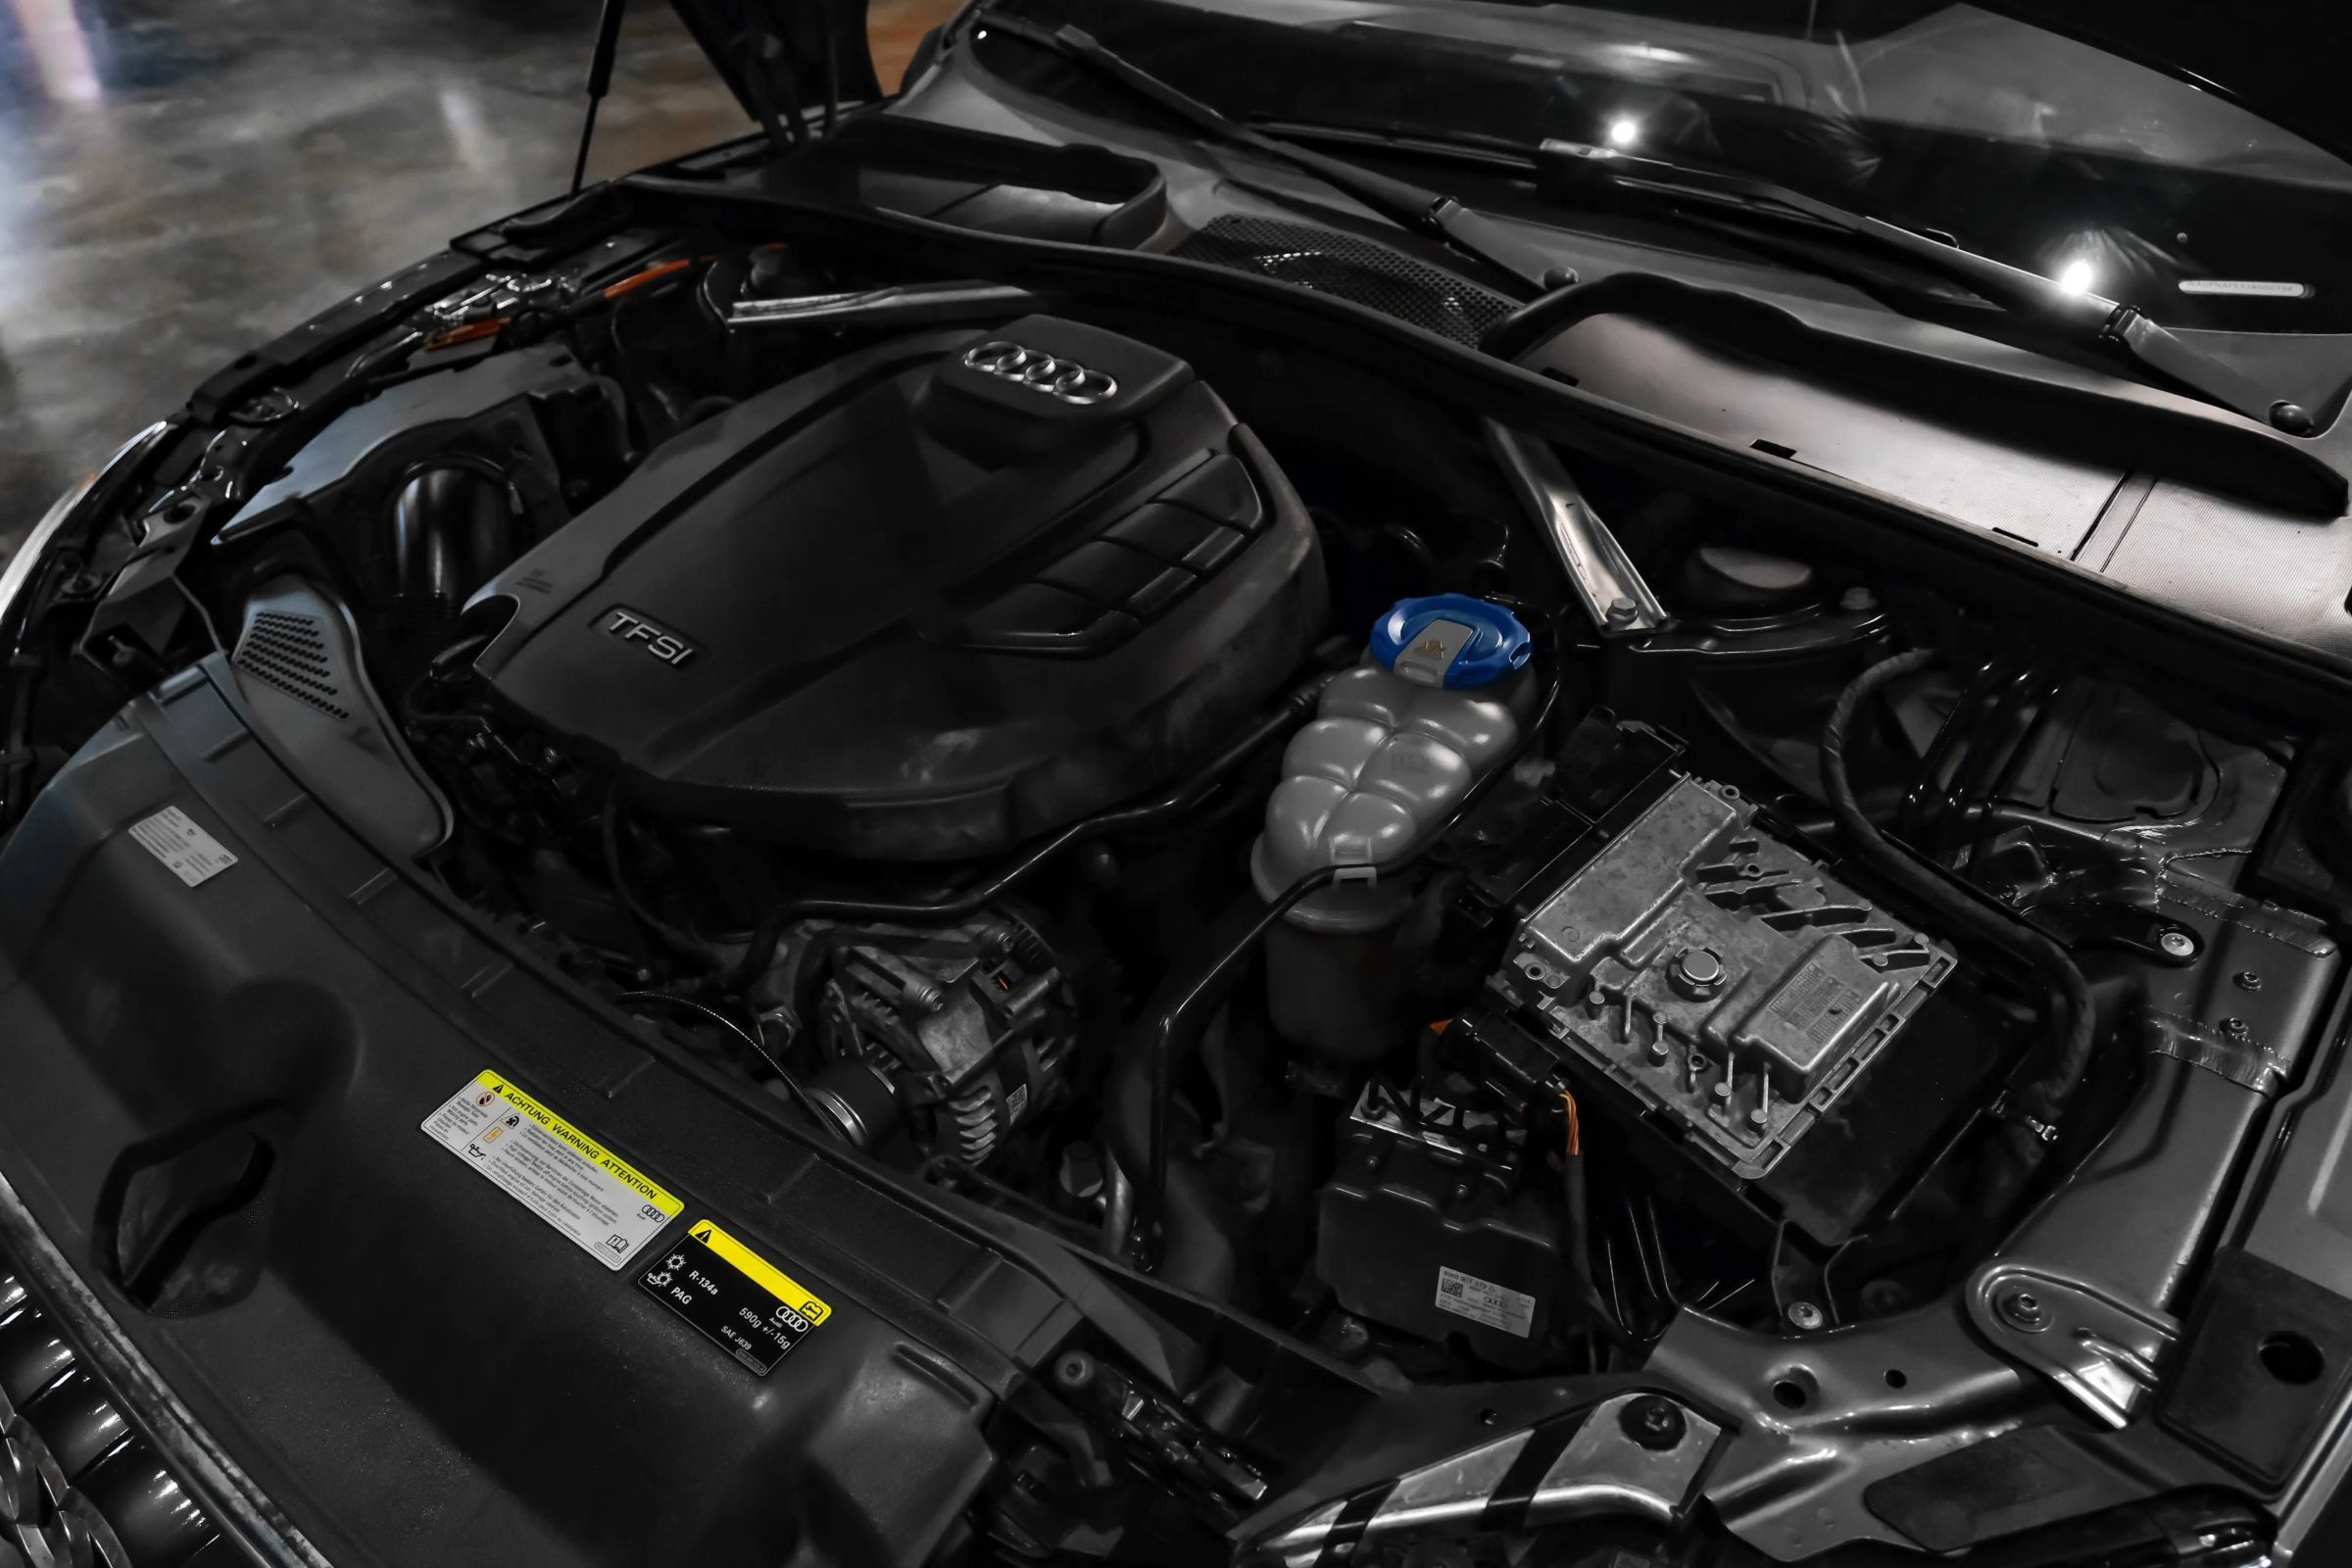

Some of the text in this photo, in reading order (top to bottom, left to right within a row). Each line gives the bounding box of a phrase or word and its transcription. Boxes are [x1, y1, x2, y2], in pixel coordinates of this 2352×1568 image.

[609, 612, 694, 664] TFSI
[504, 1091, 551, 1126] ACHTUNG
[551, 1123, 600, 1159] WARNING
[600, 1156, 658, 1200] ATTENTION
[688, 1270, 718, 1296] R-134a
[670, 1287, 692, 1305] PAG
[739, 1307, 762, 1329] 590g
[768, 1317, 782, 1329] Audi
[721, 1325, 736, 1340] SAE
